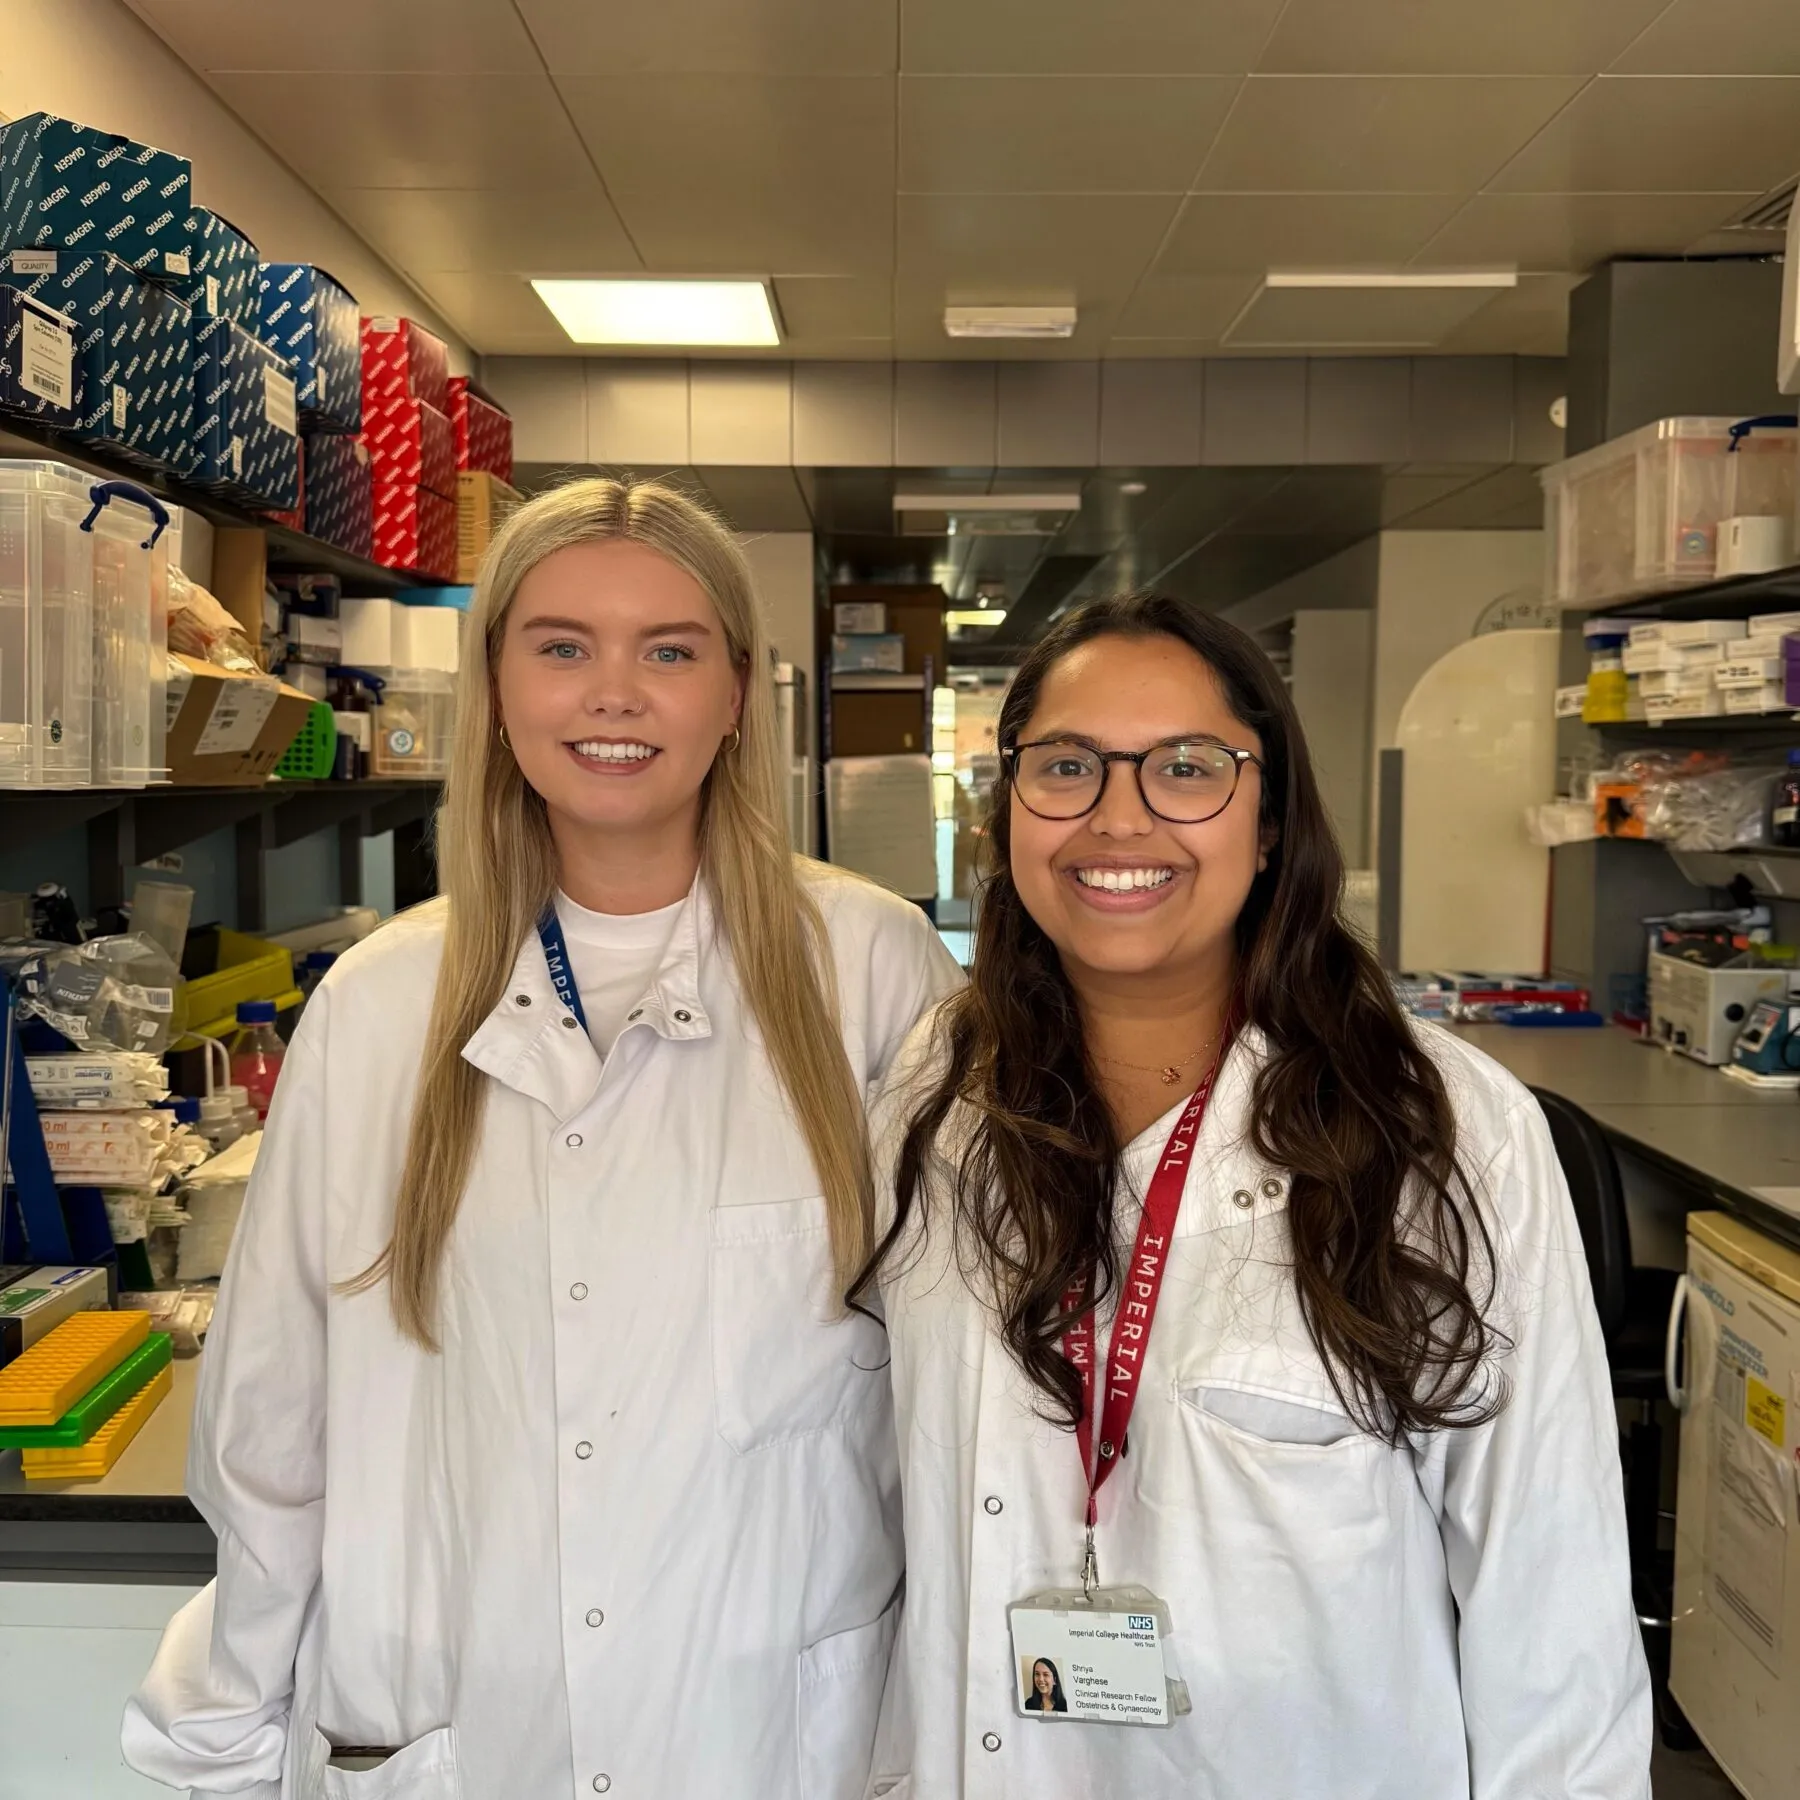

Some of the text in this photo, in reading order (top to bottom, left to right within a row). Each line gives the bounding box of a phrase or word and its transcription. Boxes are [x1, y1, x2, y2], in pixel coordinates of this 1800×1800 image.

[53, 146, 86, 173] QIAGEN
[97, 145, 128, 168] QIAGEN
[39, 185, 70, 212] QIAGEN
[80, 181, 111, 208] QIAGEN
[121, 177, 152, 203] QIAGEN
[64, 219, 96, 246] QIAGEN
[104, 215, 136, 241] QIAGEN
[145, 210, 175, 236] QIAGEN
[21, 262, 49, 270] QUALITY
[62, 256, 95, 288] QIAGEN
[133, 247, 159, 271] QIAGE
[544, 941, 576, 1014] IMPE
[1110, 1233, 1164, 1401] IMPERIAL
[1068, 1629, 1155, 1641] Imperial College Healthcare
[1129, 1617, 1152, 1629] NHS
[1072, 1664, 1094, 1673] Shriya
[1073, 1676, 1108, 1686] Varghese
[1075, 1690, 1157, 1702] Clinical Research Fellow
[1076, 1701, 1162, 1715] Obstetrics & Gynaecology
